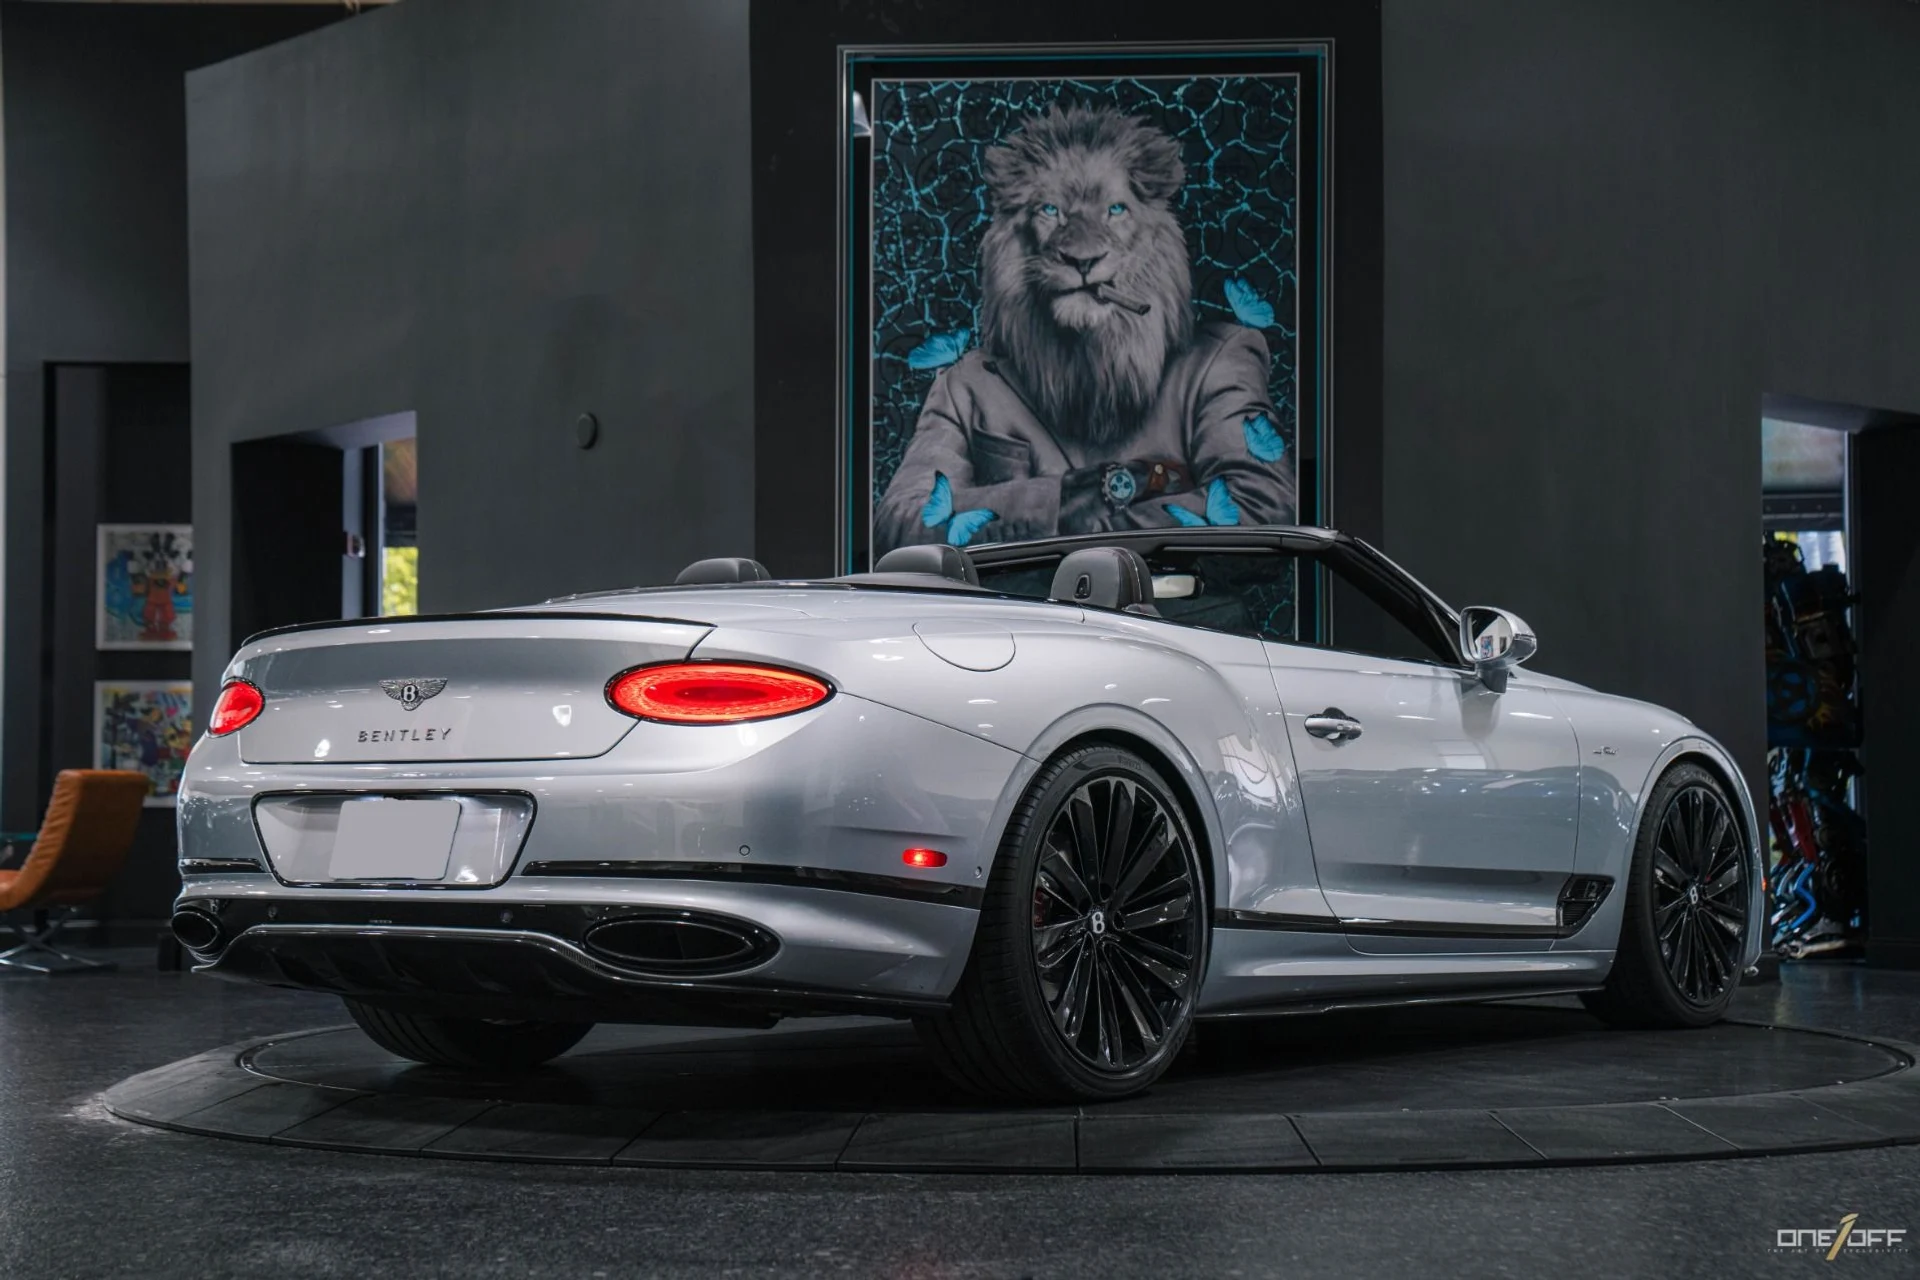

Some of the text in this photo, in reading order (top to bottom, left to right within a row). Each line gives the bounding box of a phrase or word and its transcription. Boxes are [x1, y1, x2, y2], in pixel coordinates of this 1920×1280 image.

[403, 685, 416, 702] B
[358, 728, 452, 743] BENTLEY
[1690, 886, 1699, 904] B
[1091, 911, 1105, 934] B
